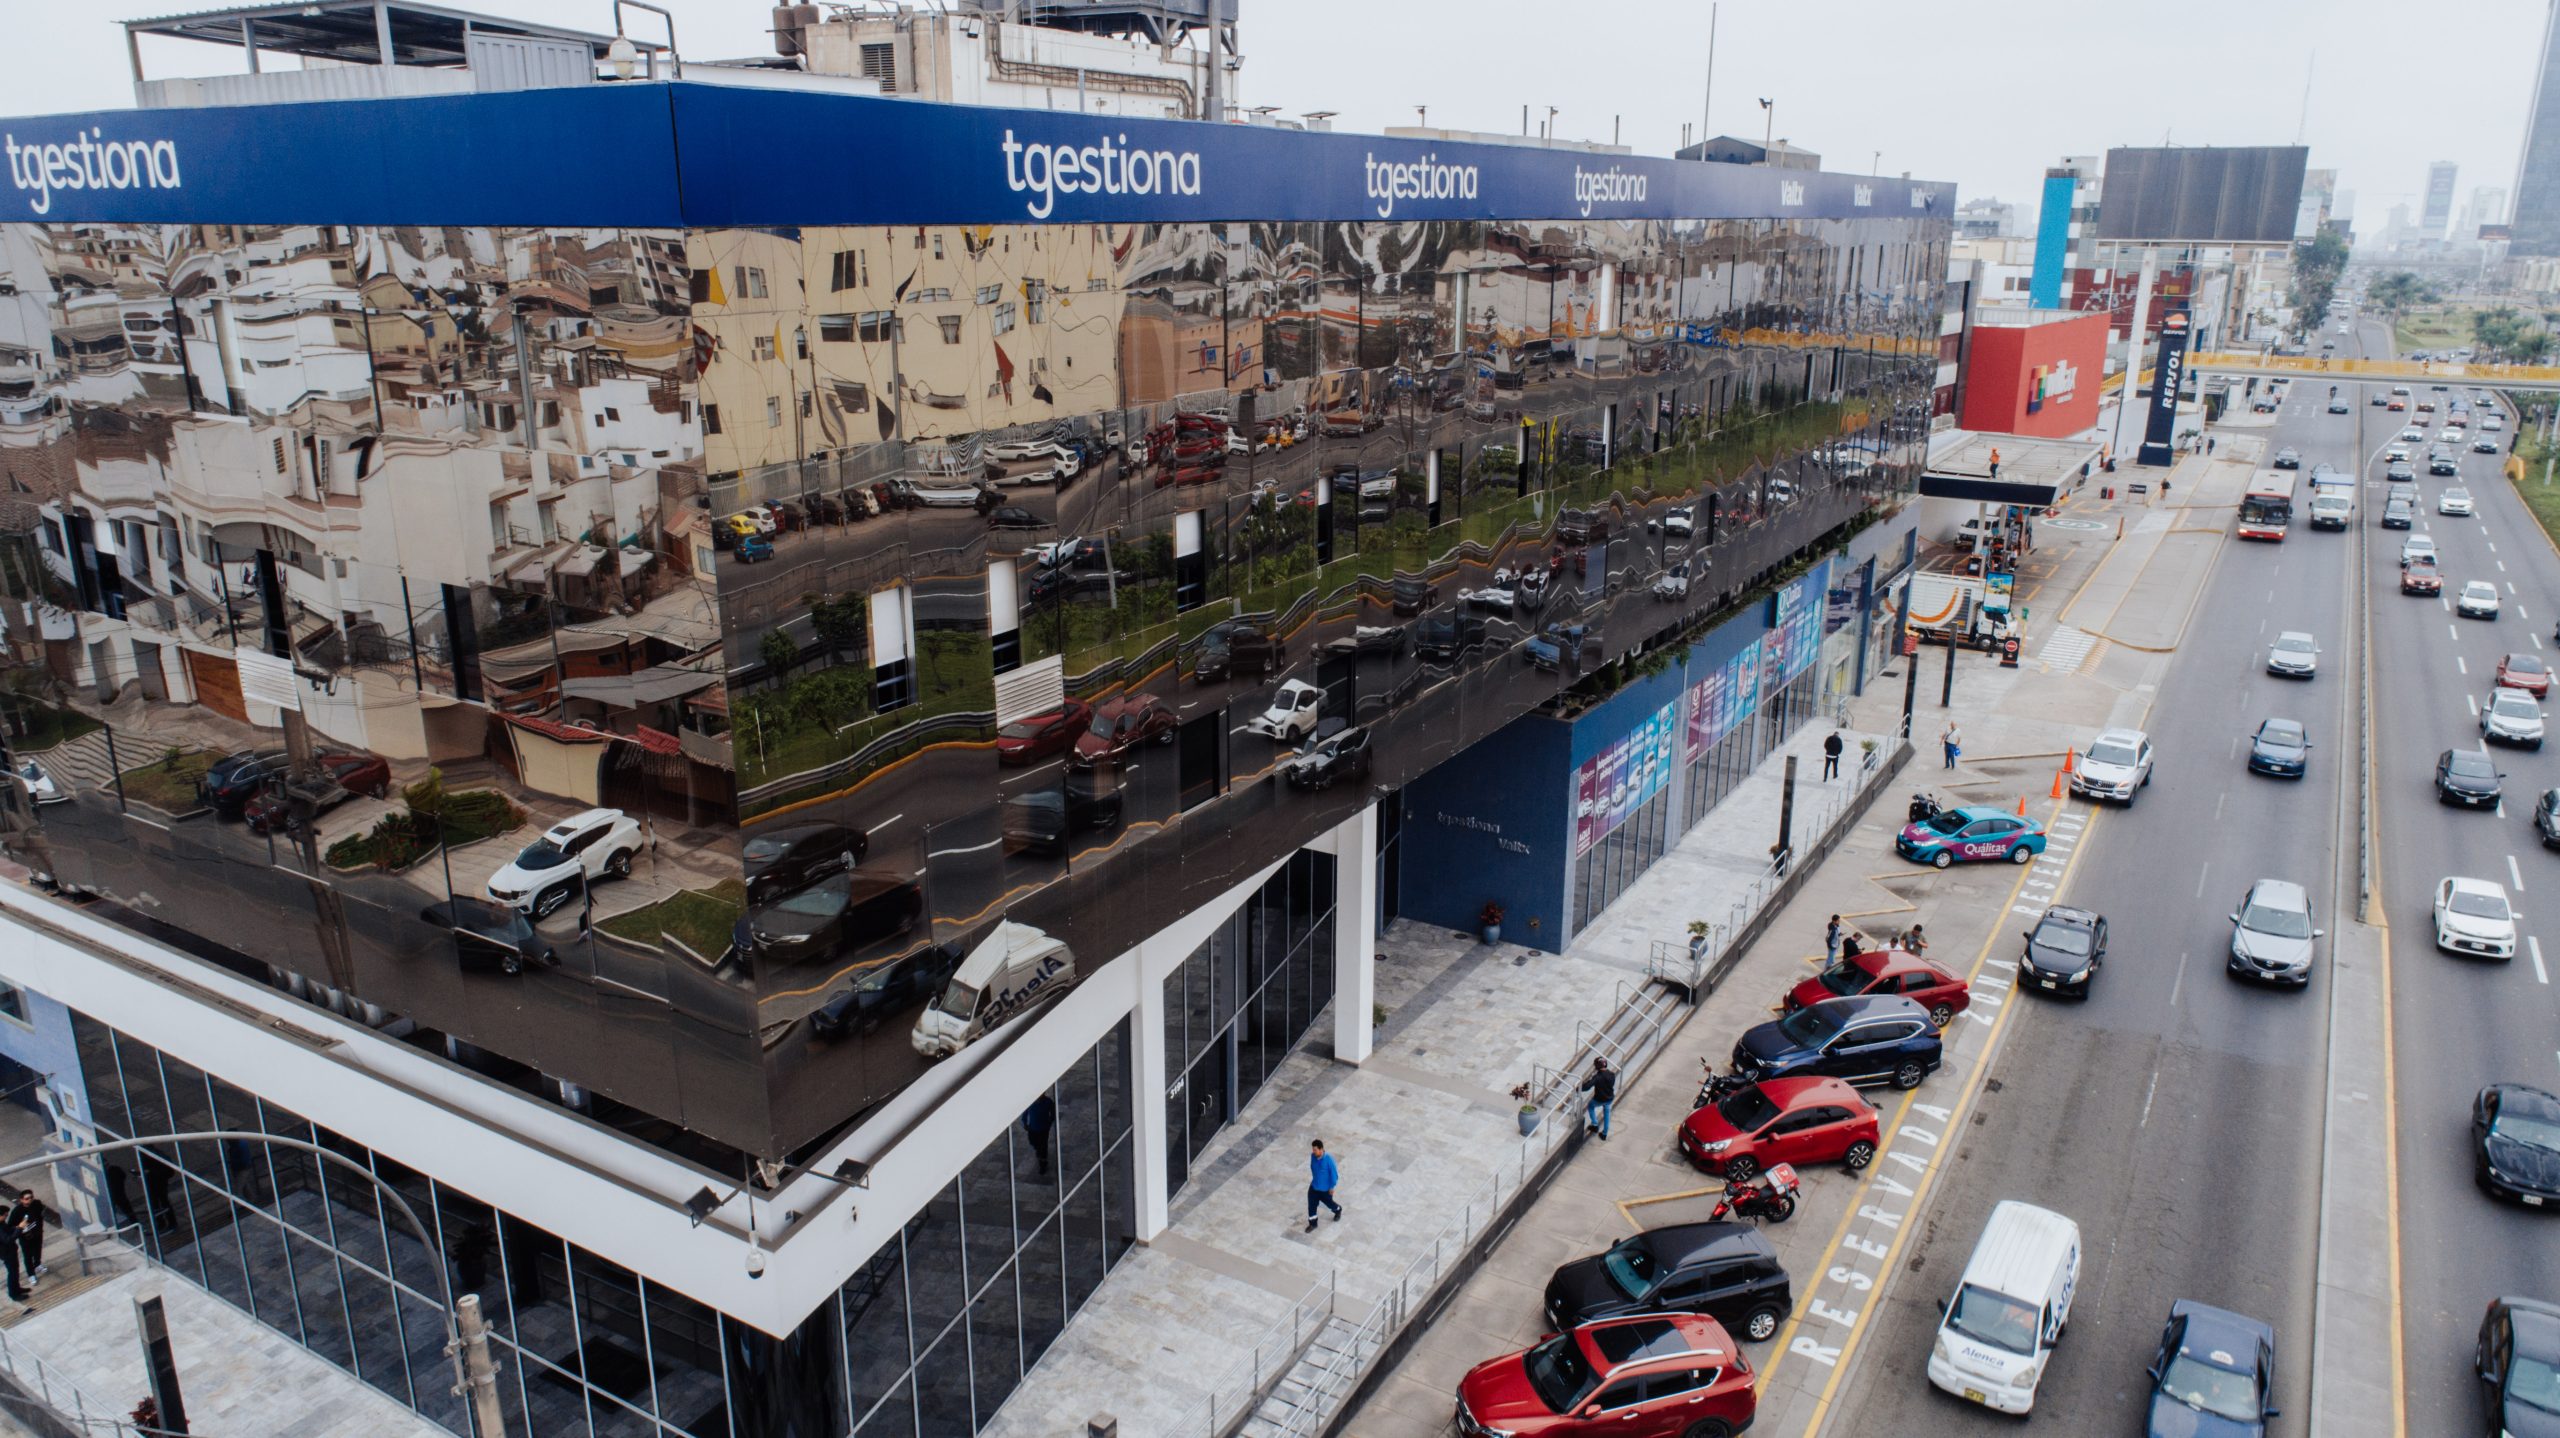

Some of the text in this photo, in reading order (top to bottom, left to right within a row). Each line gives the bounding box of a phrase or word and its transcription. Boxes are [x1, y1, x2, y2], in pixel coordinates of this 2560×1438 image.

[6, 128, 181, 215] tgestiona
[1002, 129, 1201, 219] tgestiona
[1365, 152, 1478, 219] tgestiona
[1575, 165, 1647, 217] tgestiona
[2162, 349, 2182, 409] REPSOL
[1965, 843, 2007, 855] Quálitas
[1957, 813, 2088, 1026] ZONA RESERVADA
[1789, 1102, 1952, 1367] RESERVADA
[1961, 1346, 2005, 1367] Alenca
